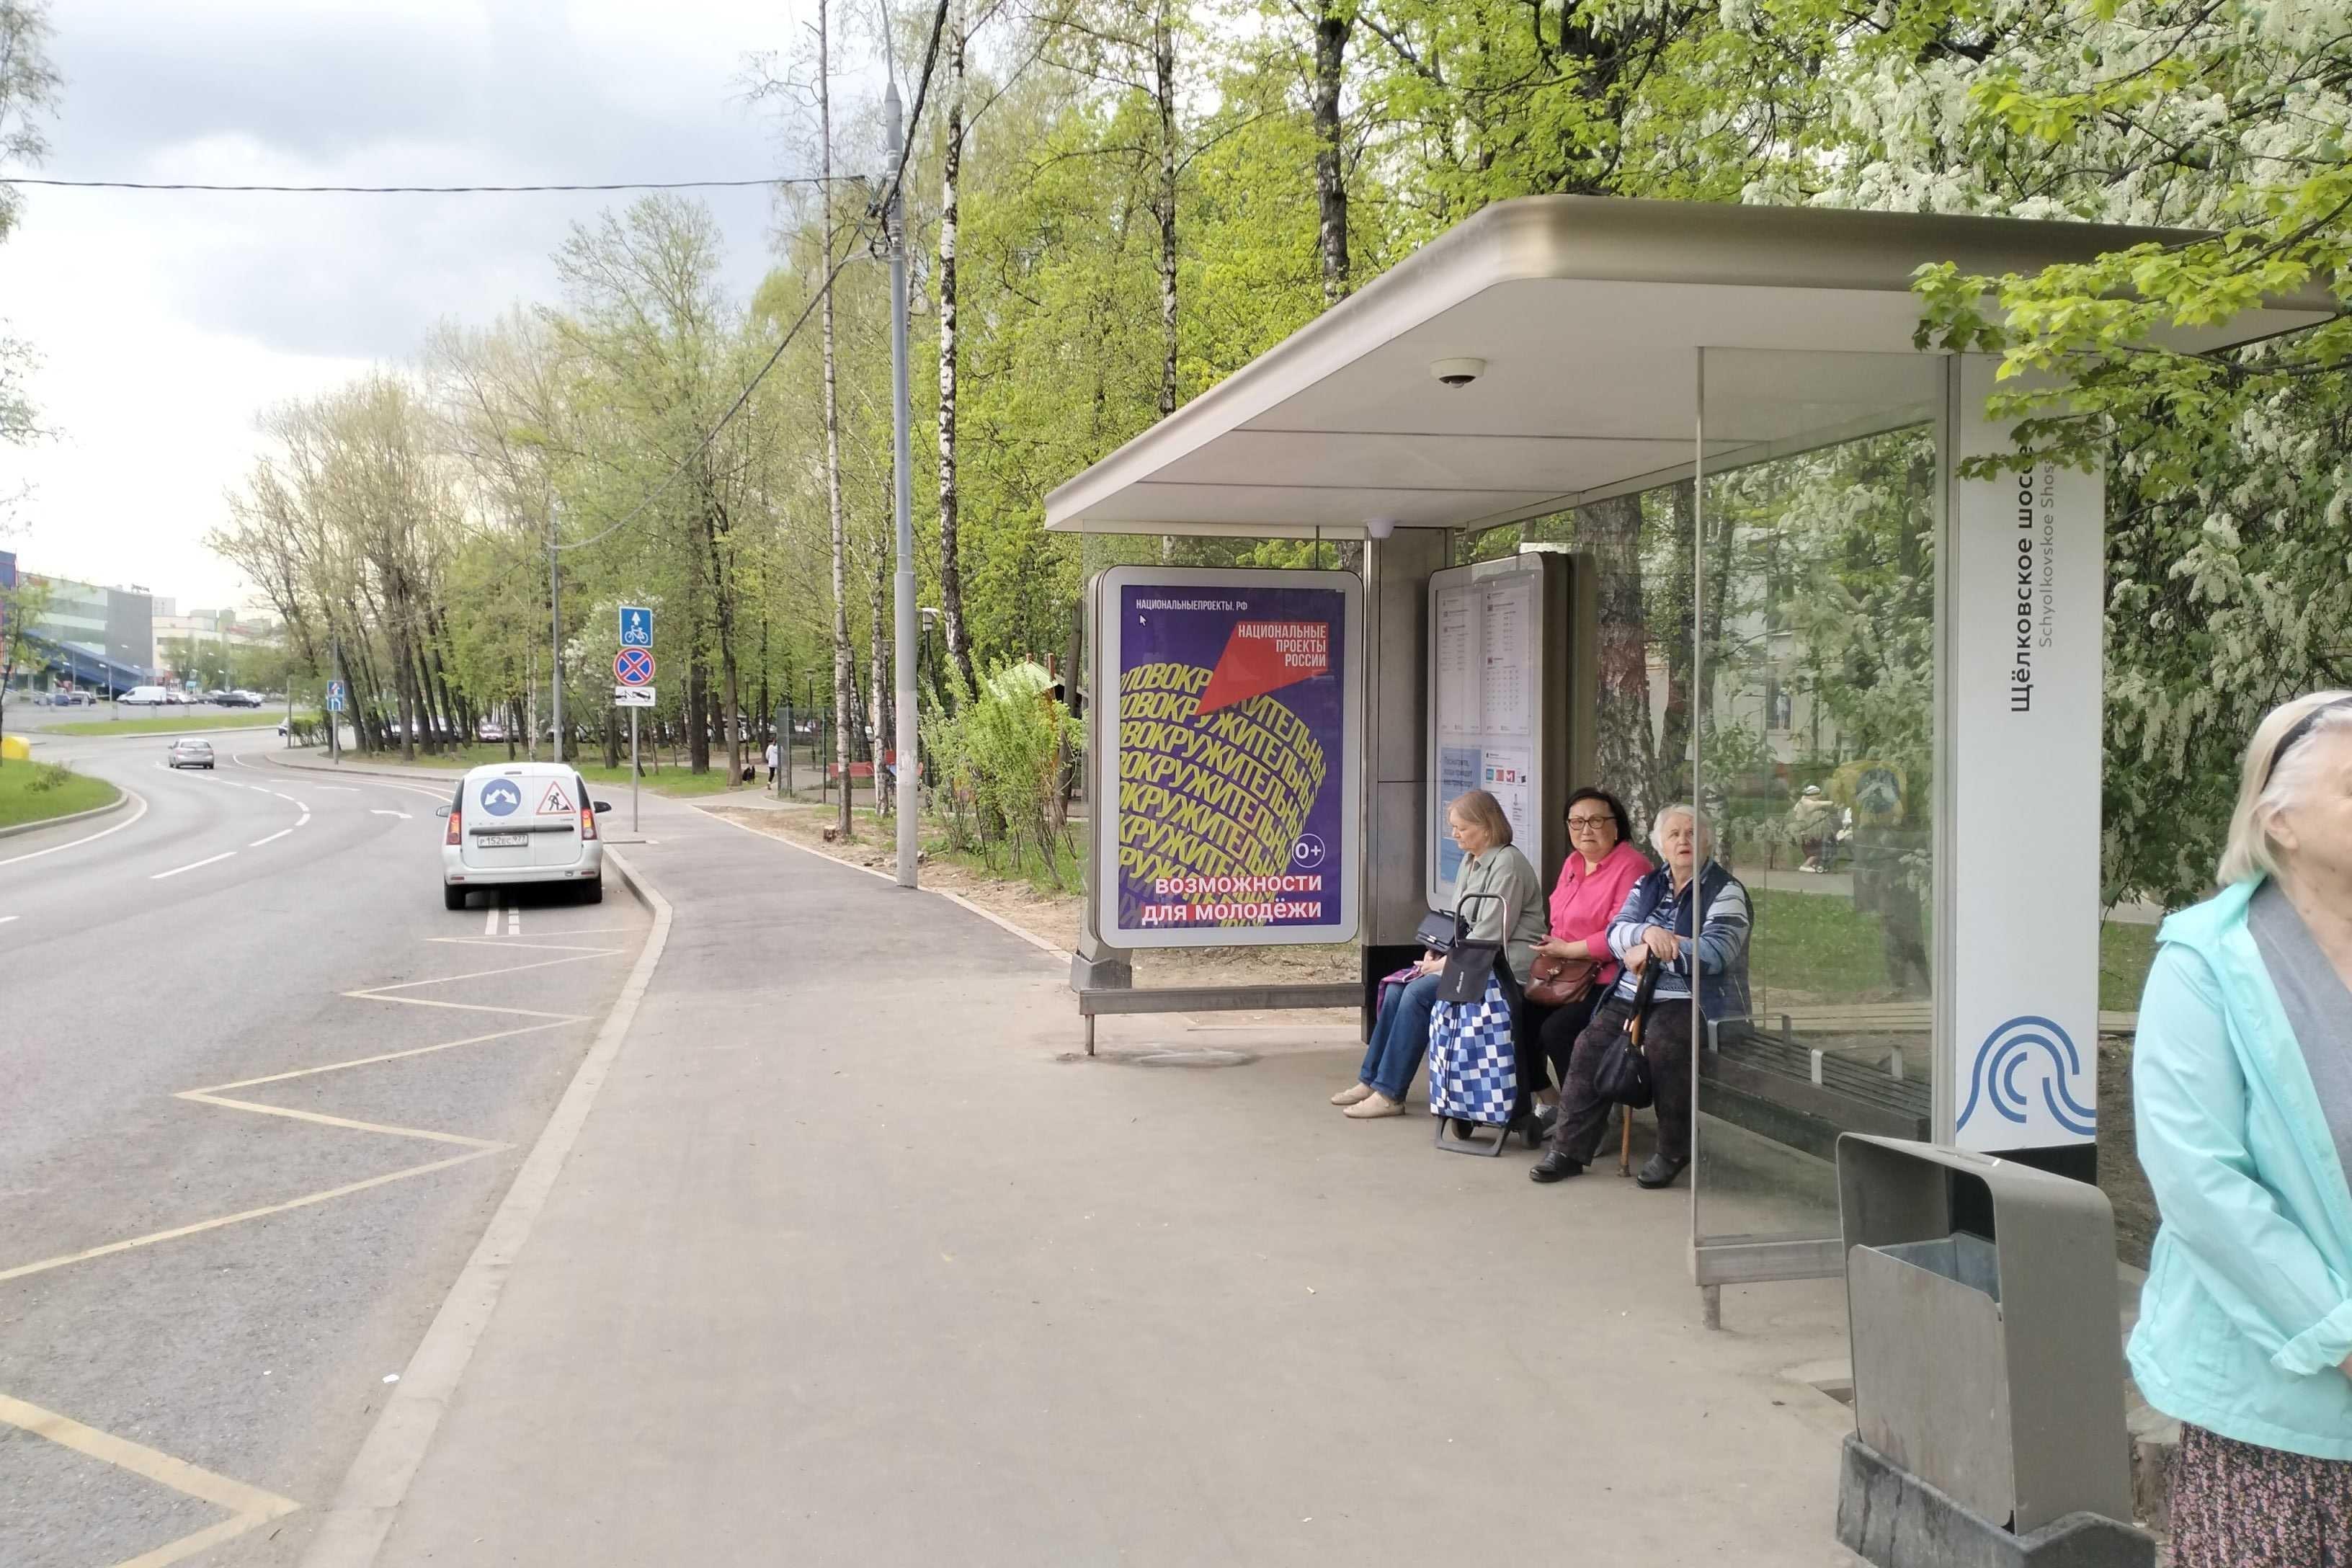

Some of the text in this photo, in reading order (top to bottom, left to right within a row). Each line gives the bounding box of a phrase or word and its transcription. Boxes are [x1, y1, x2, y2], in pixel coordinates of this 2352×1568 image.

[2039, 459, 2056, 647] Schyolkovskoe Shos
[1238, 625, 1327, 639] НАЦИОНАЛЬНЫЕ
[2011, 538, 2034, 712] Щёлковское
[1276, 639, 1327, 652] ПРОЕКТЫ
[1285, 654, 1327, 667] РОССИИ
[1141, 904, 1187, 925] для
